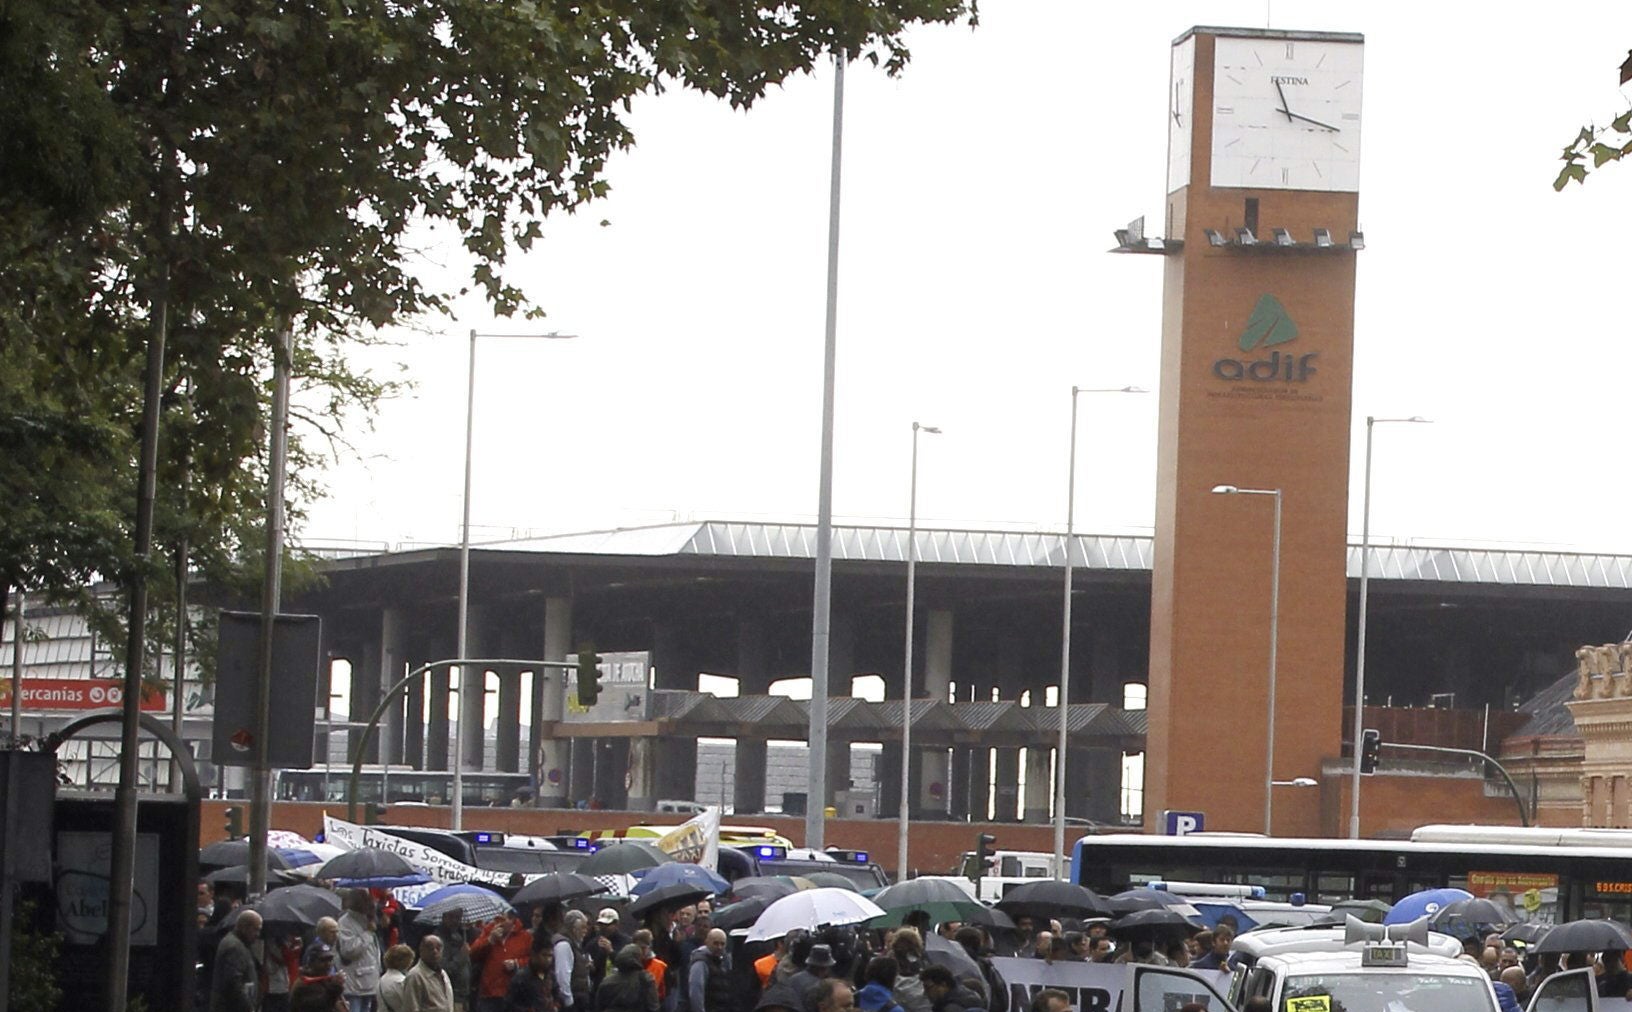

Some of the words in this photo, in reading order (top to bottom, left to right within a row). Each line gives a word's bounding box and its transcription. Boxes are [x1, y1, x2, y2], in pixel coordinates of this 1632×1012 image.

[1270, 76, 1309, 86] FESTINA
[1214, 350, 1319, 382] adif
[21, 686, 83, 702] ercanías
[1176, 815, 1197, 837] P
[361, 827, 416, 859] Taxistas
[421, 847, 467, 872] Somos
[1372, 948, 1395, 961] TAXI
